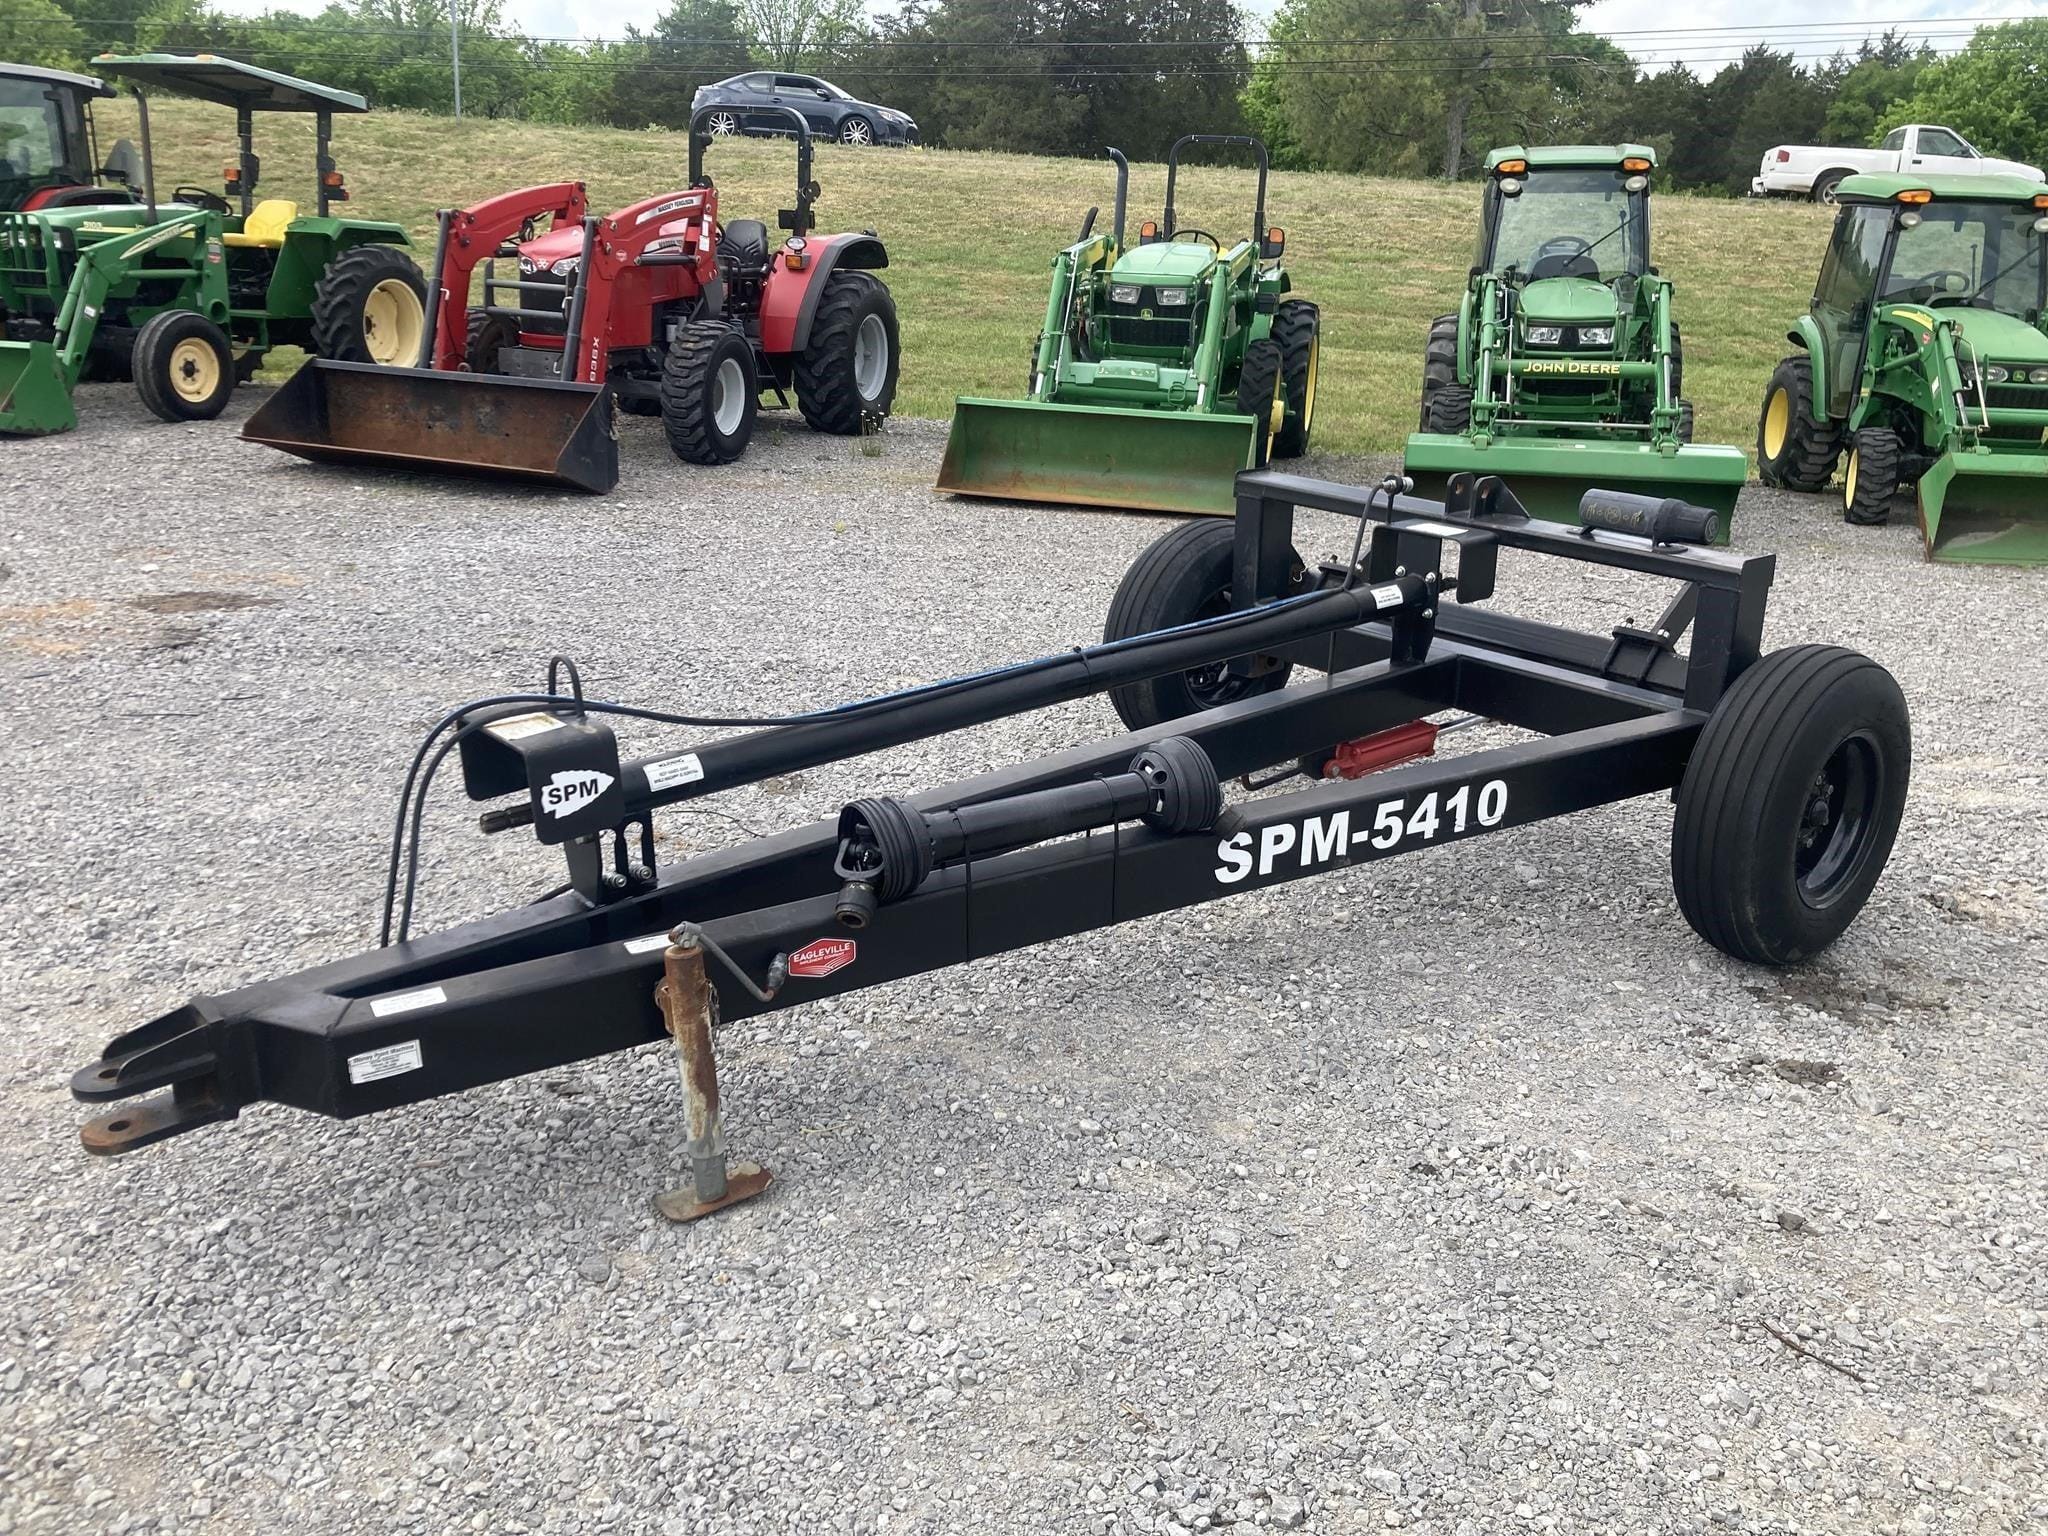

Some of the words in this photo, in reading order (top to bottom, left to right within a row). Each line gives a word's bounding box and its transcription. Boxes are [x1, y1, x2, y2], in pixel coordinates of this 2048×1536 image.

[1523, 362, 1564, 373] JOHN
[1568, 363, 1620, 374] DEERE
[548, 778, 599, 805] SPM
[1214, 779, 1508, 884] SPM-5410
[793, 943, 850, 963] EAGLEVILLE
